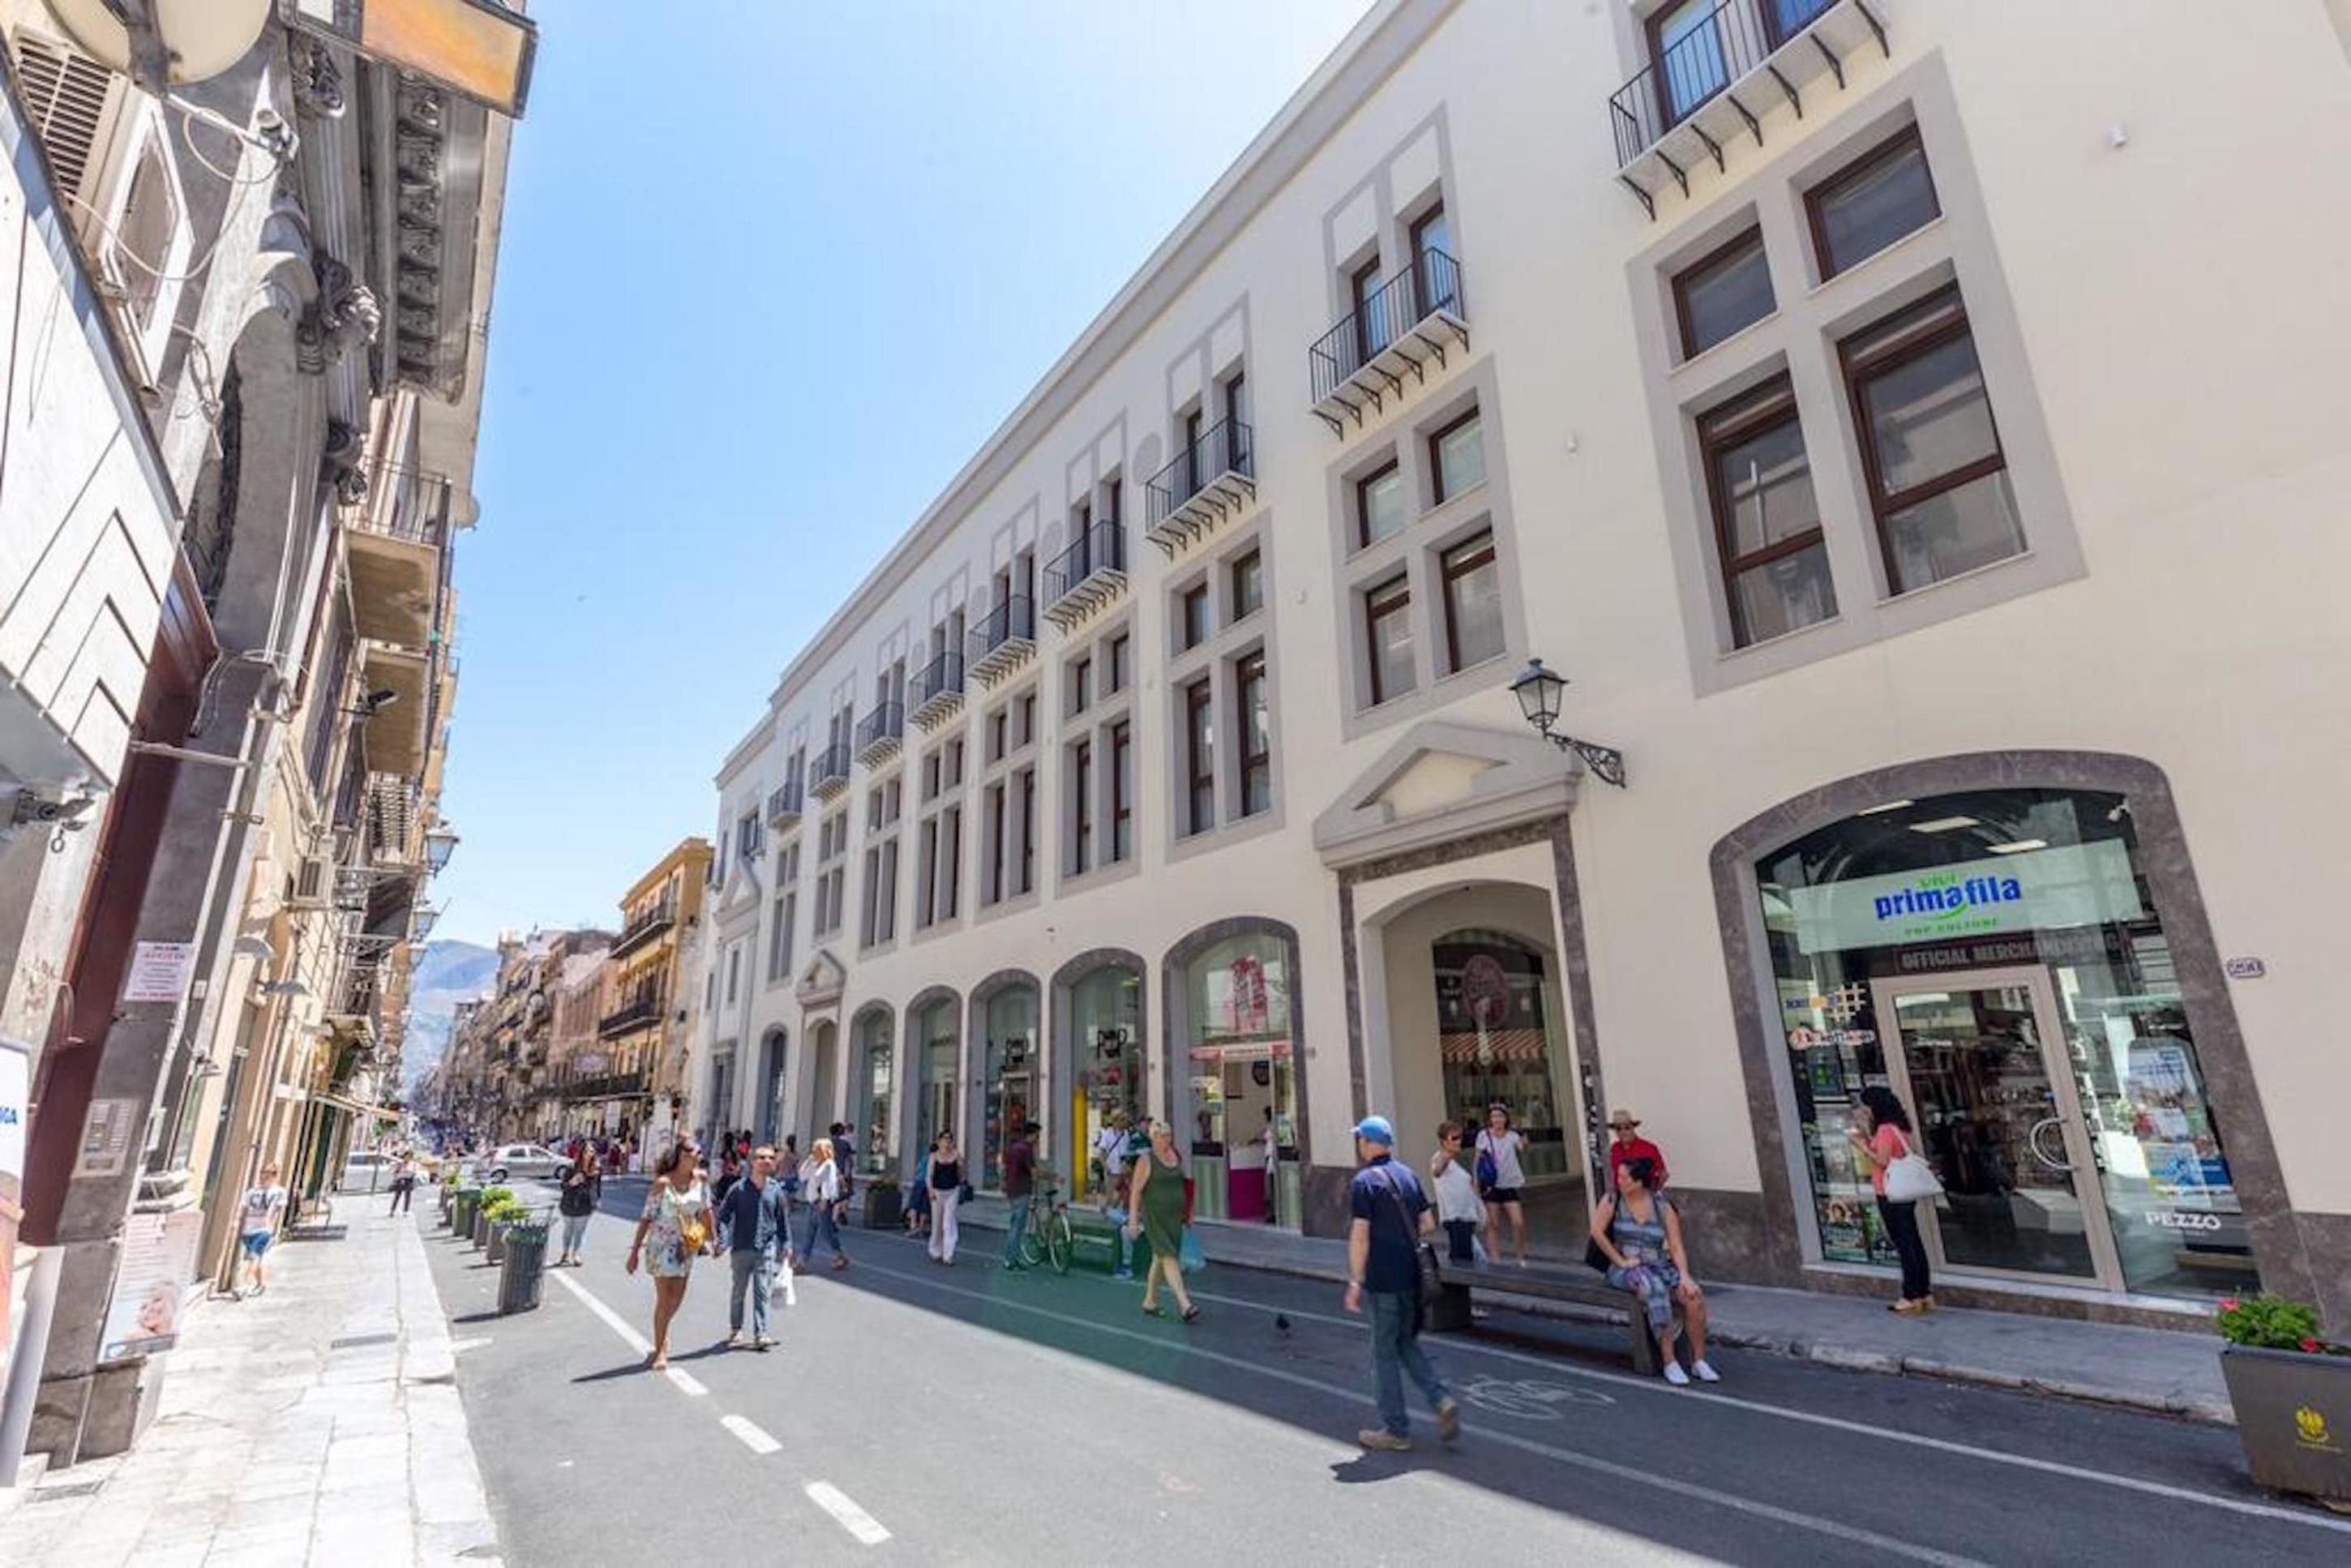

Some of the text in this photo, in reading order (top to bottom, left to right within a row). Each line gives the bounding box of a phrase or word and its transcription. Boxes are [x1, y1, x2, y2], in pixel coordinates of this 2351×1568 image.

[1874, 875, 2022, 920] primafila
[1901, 945, 1970, 969] OFFICIAL
[2144, 1210, 2222, 1232] PEZZO
